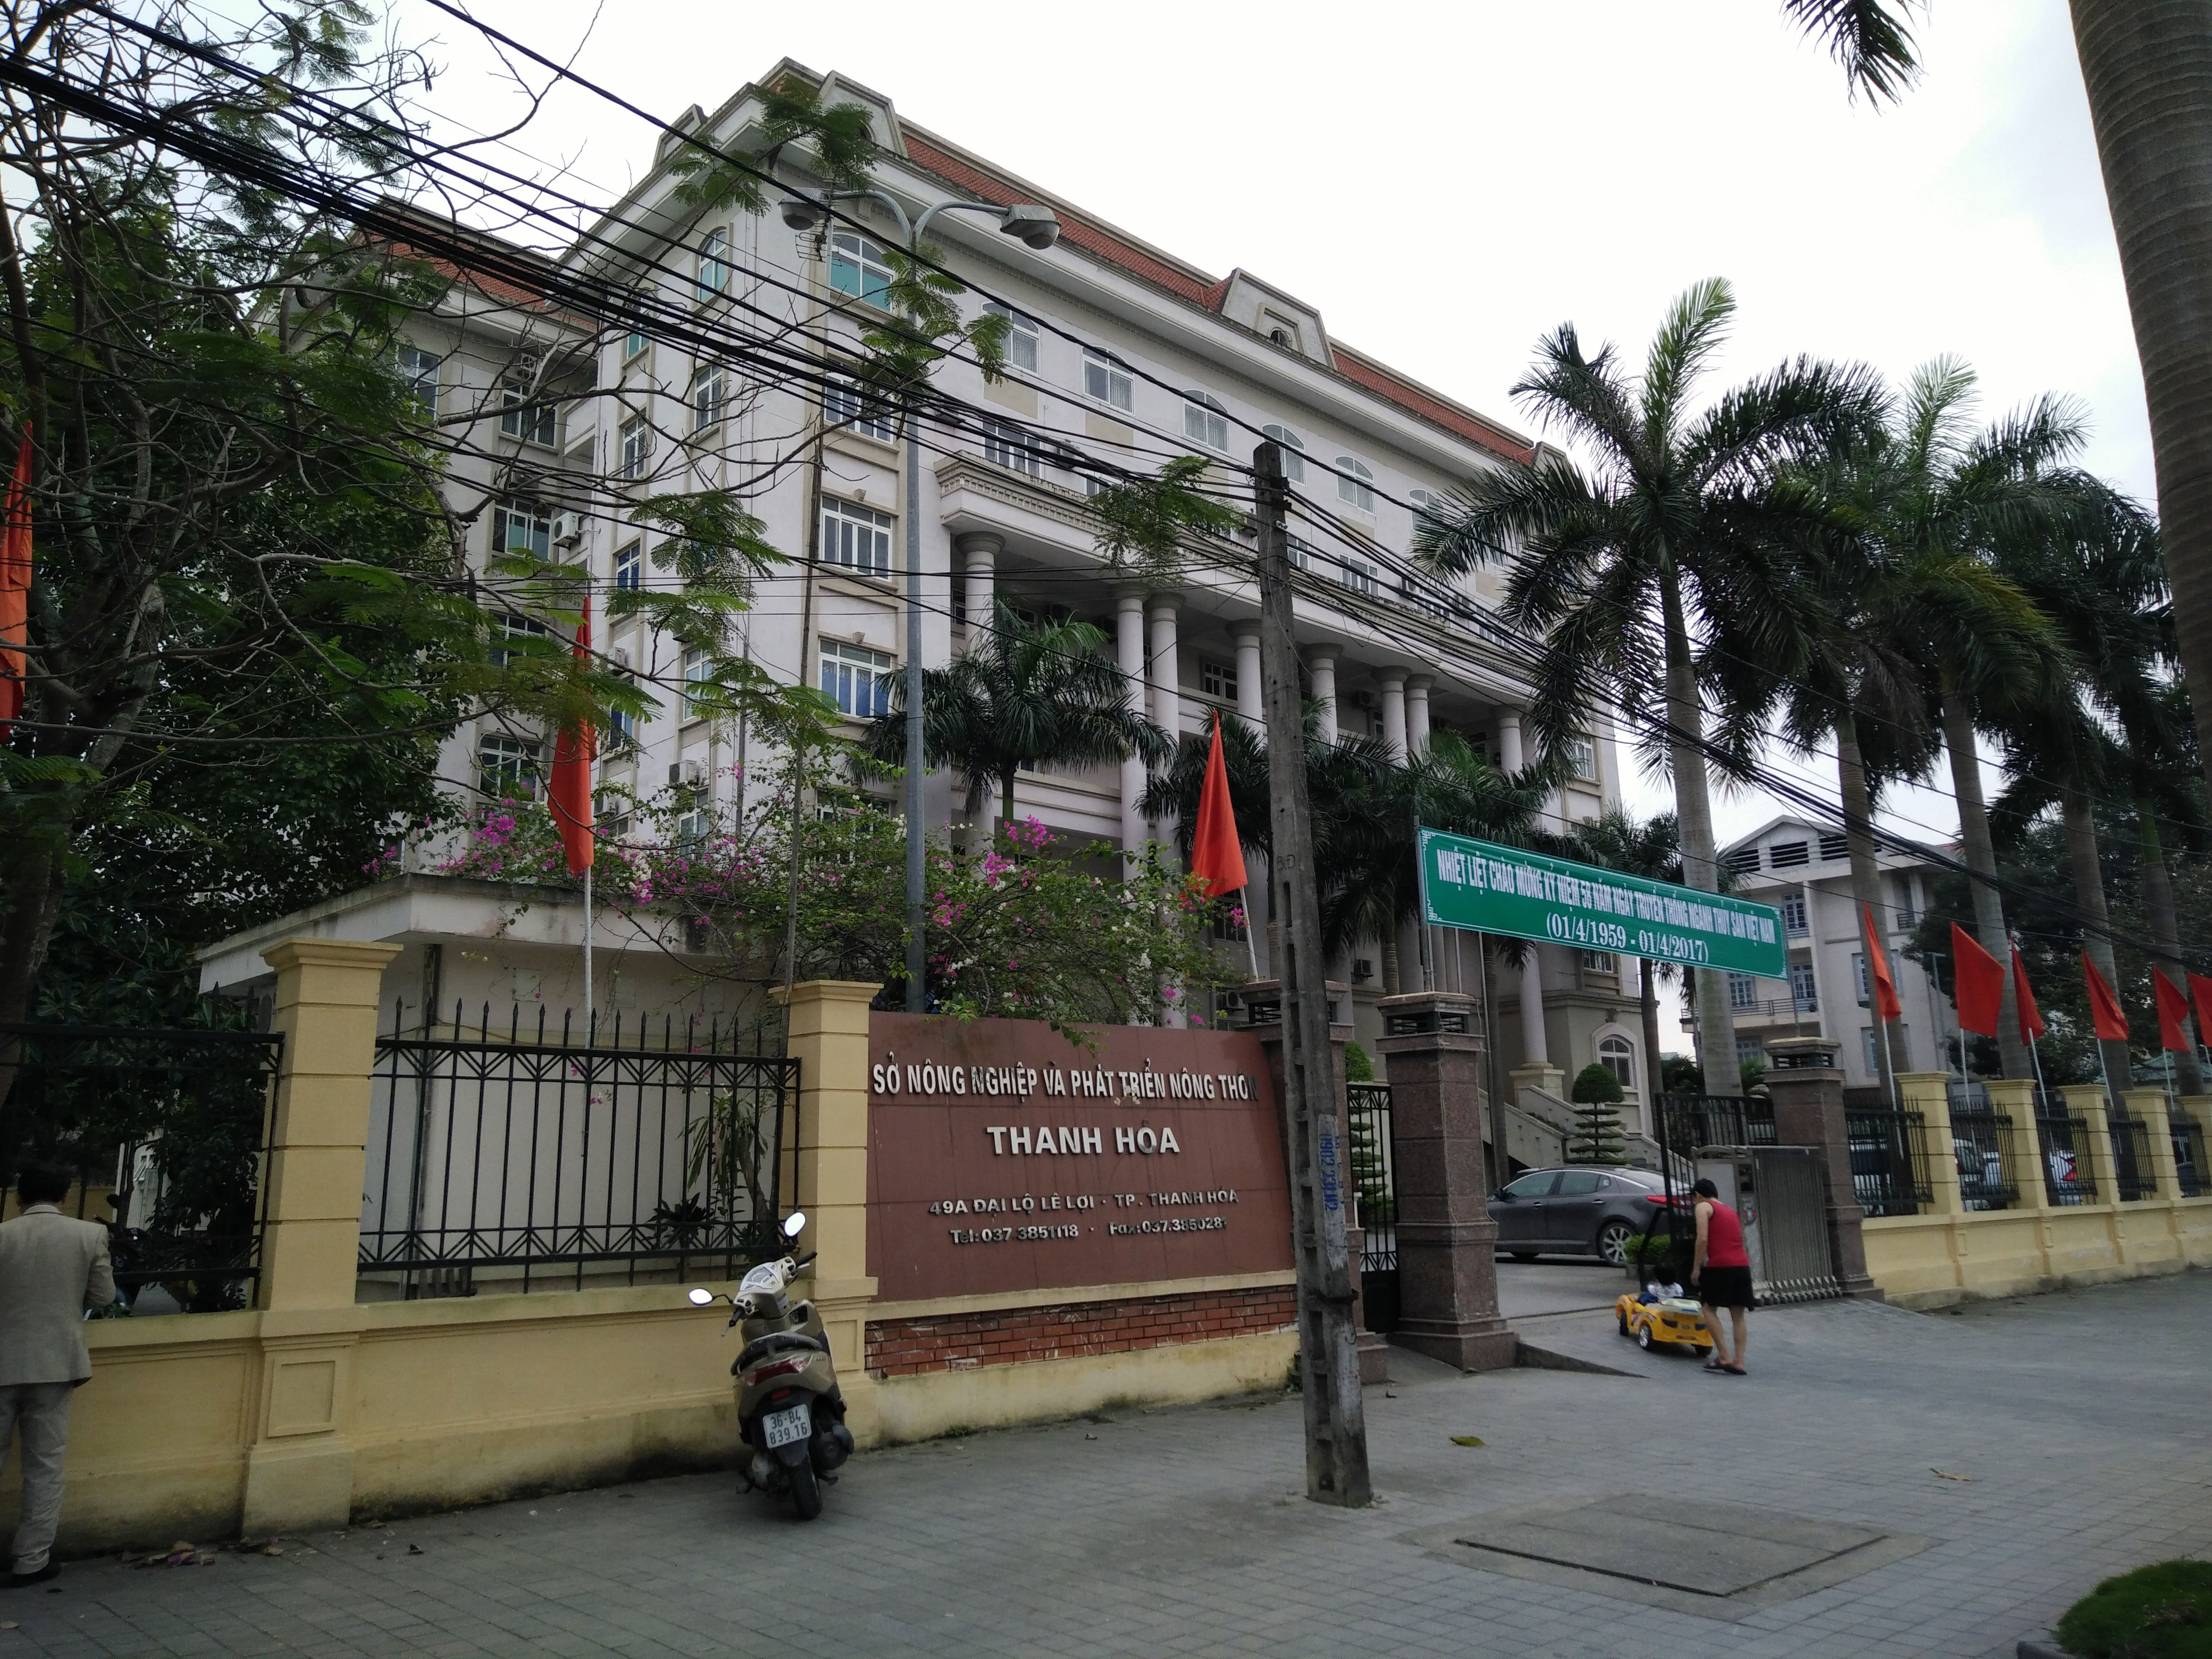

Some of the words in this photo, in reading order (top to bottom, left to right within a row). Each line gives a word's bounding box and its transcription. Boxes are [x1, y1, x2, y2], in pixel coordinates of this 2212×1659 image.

[1437, 846, 1467, 891] NHIỆT
[1467, 851, 1488, 895] LIỆT
[1489, 856, 1515, 894] CHÀO
[1515, 860, 1544, 900] MỪNG
[1544, 862, 1556, 902] KỶ
[1556, 870, 1581, 912] NIỆM
[1580, 880, 1592, 909] 58
[1591, 877, 1613, 913] NĂM
[1612, 883, 1634, 917] NGÀY
[1634, 885, 1664, 923] TRUYỀN
[1663, 890, 1689, 928] THỐNG
[1688, 898, 1713, 932] NGÀNH
[1730, 903, 1747, 939] SẢN
[1744, 909, 1760, 946] VIỆT
[1758, 916, 1776, 944] NAM
[1546, 912, 1626, 948] (01/4/1959
[1639, 929, 1708, 964] 01/4/2017)
[873, 1051, 900, 1094] SỞ
[907, 1058, 966, 1095] NÔNG
[970, 1061, 1037, 1103] NGHIỆP
[1042, 1060, 1066, 1095] VÀ
[1070, 1063, 1114, 1097] PHÁT
[1118, 1057, 1166, 1098] TRIỂN
[1169, 1067, 1216, 1099] NÔNG
[986, 1126, 1102, 1154] THANH
[1115, 1119, 1181, 1153] HÒA
[929, 1200, 969, 1214] 49A
[973, 1197, 1007, 1217] ĐẠI
[1012, 1193, 1035, 1214] LỘ
[1041, 1193, 1061, 1210] LÊ
[1066, 1195, 1094, 1213] LỢI
[1148, 1192, 1203, 1206] THANH
[769, 1422, 807, 1445] 839.16
[770, 1409, 801, 1429] 36-B4
